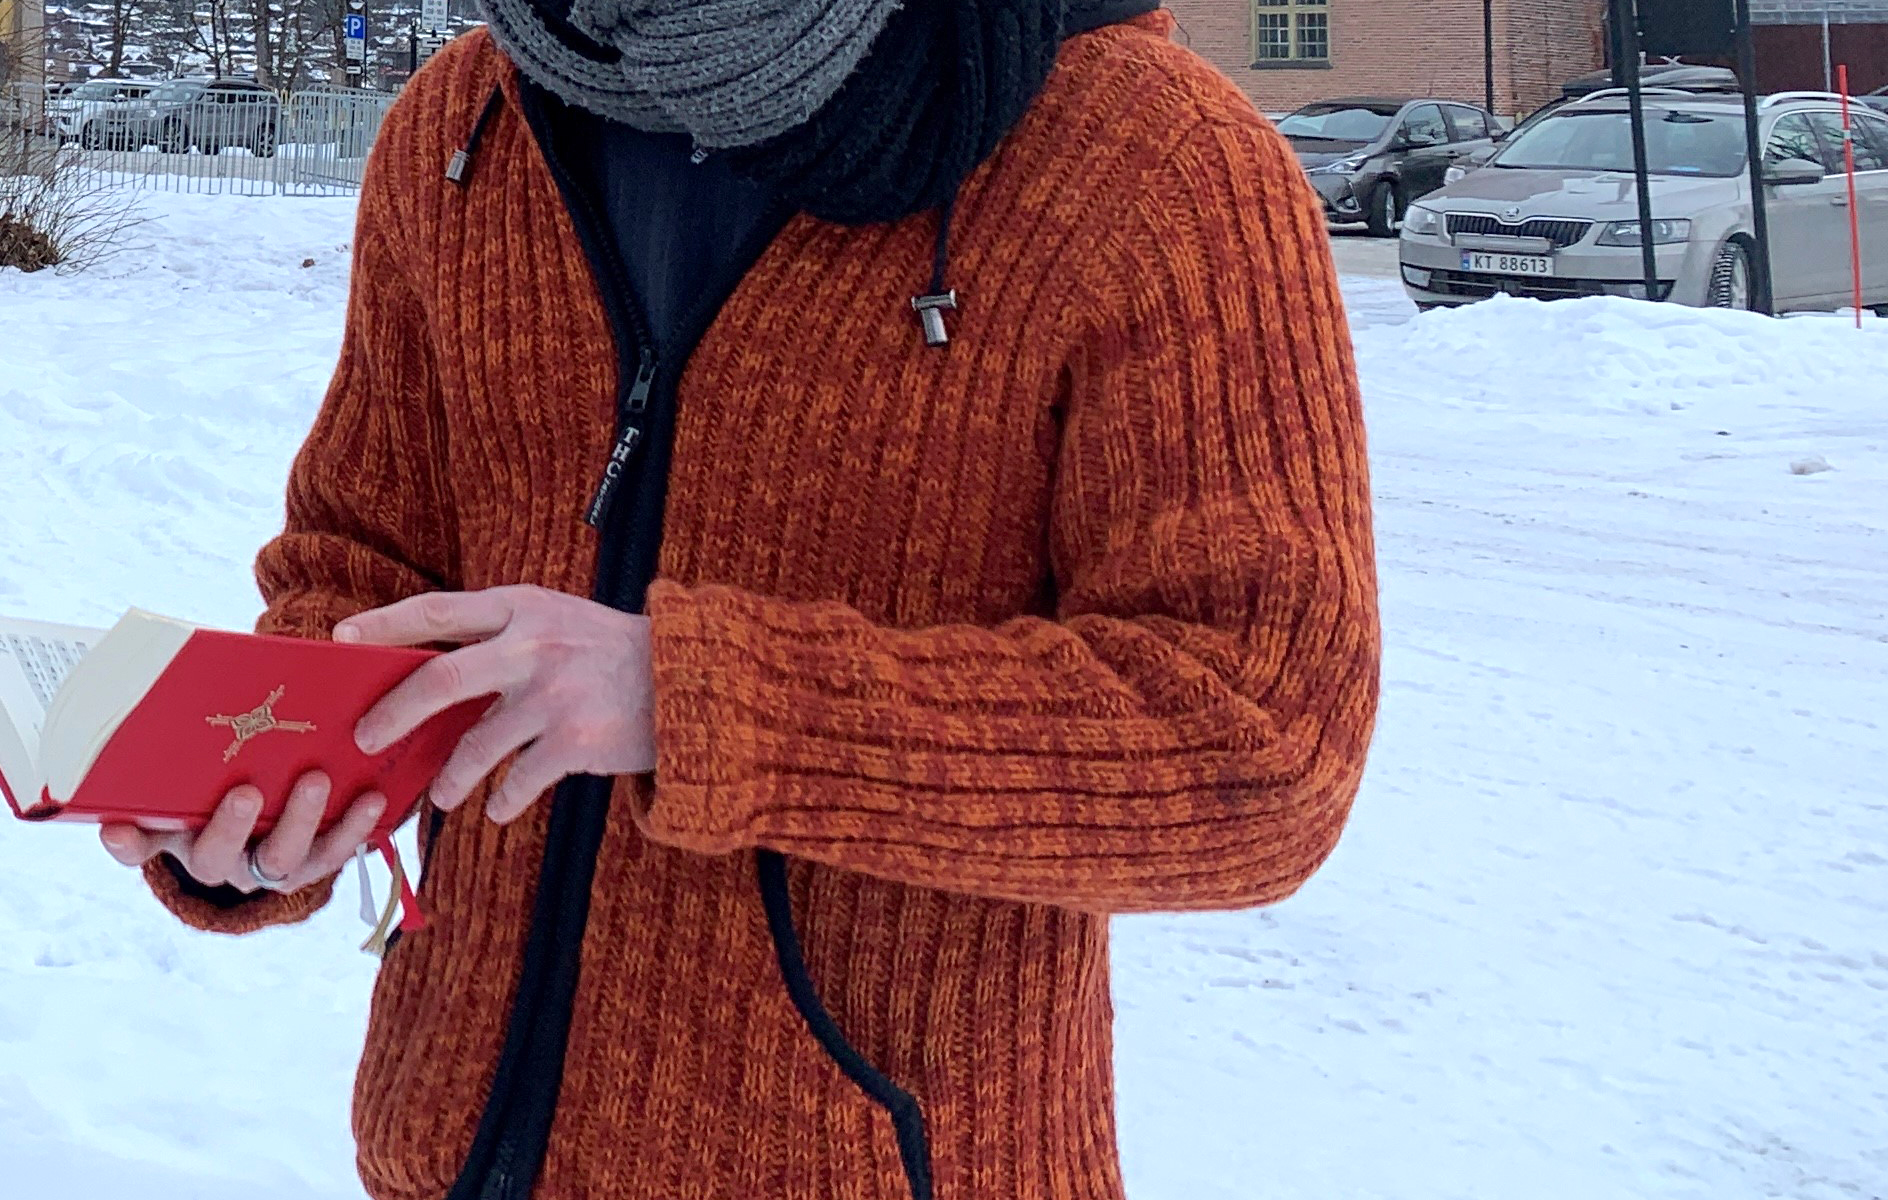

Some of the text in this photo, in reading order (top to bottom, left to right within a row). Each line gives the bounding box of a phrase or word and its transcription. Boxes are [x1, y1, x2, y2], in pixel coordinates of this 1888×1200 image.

[350, 17, 361, 36] P
[1474, 255, 1548, 273] KT 88613
[606, 426, 640, 478] THC
